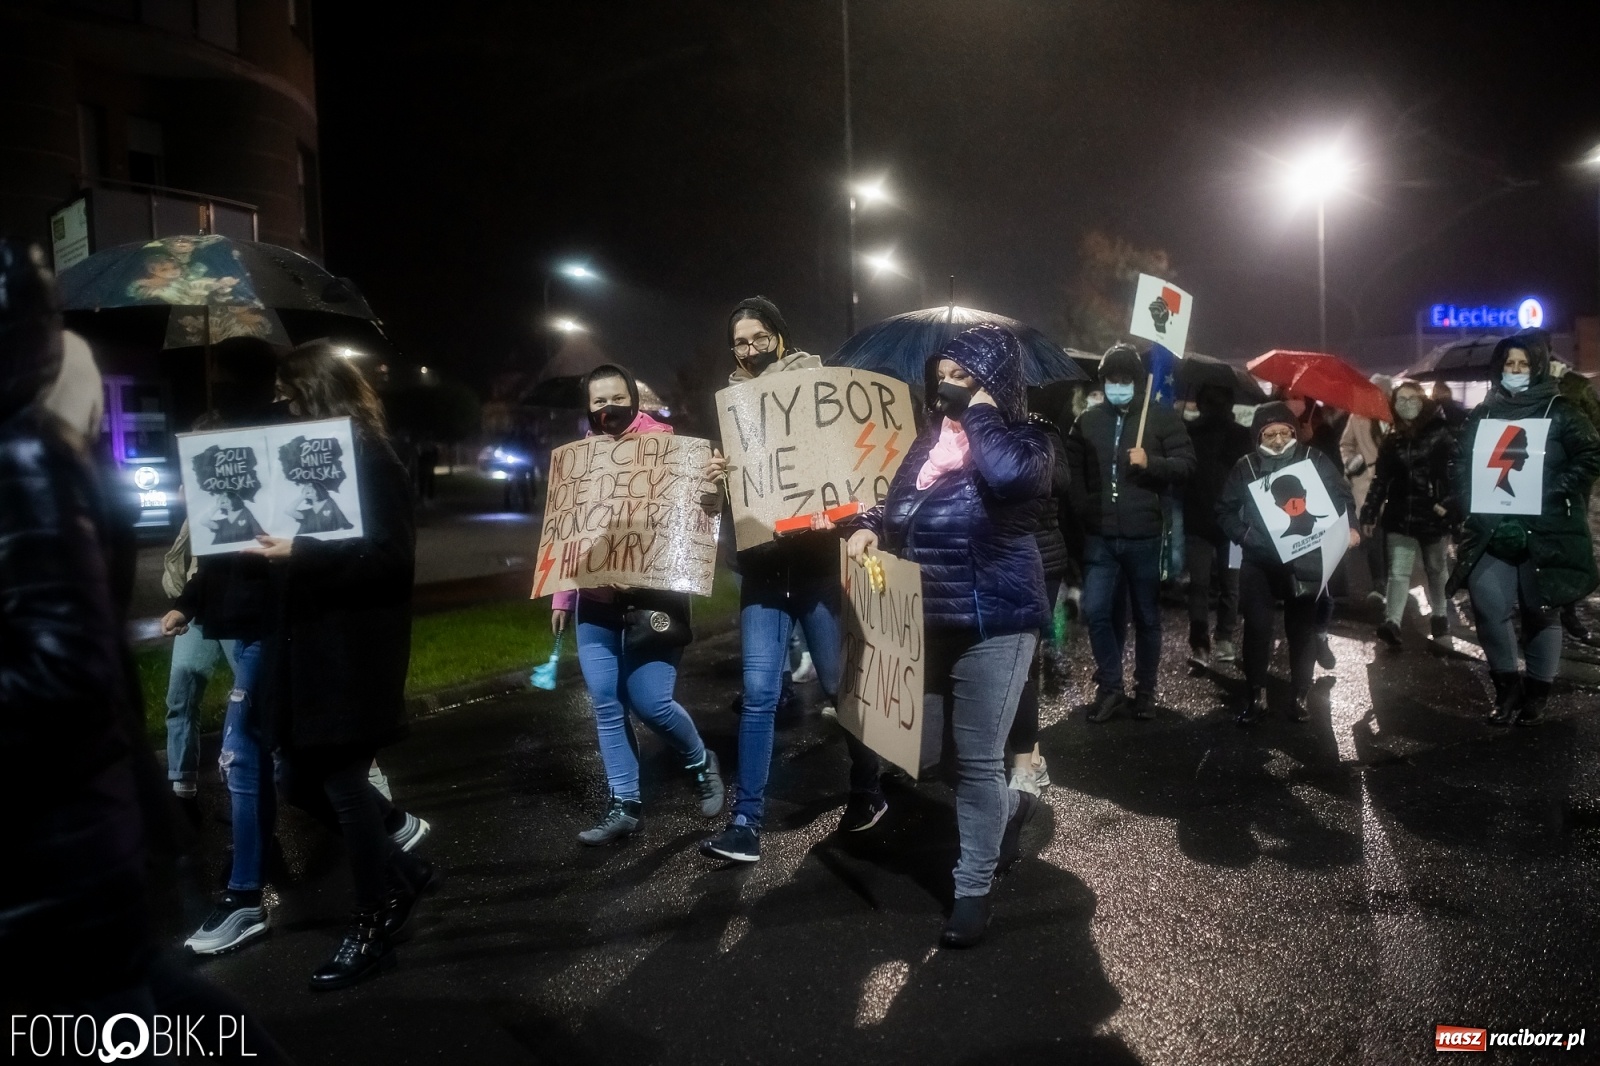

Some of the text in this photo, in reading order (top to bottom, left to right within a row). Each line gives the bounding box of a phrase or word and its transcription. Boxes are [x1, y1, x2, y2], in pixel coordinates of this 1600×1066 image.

[1431, 304, 1518, 327] E.Leclerc
[728, 370, 902, 452] WYBÓR
[214, 449, 247, 467] BOLI
[300, 440, 332, 457] BOLI
[300, 452, 333, 468] MNIE
[215, 462, 248, 478] MNIE
[289, 464, 341, 481] POLSKA
[552, 437, 713, 485] MOJE CIAŁO
[203, 473, 256, 491] POLSKA
[743, 446, 799, 507] NIE
[546, 479, 592, 517] MOJE
[855, 567, 875, 630] NIC
[889, 587, 921, 662] NAS
[845, 632, 915, 731] BEZ NAS
